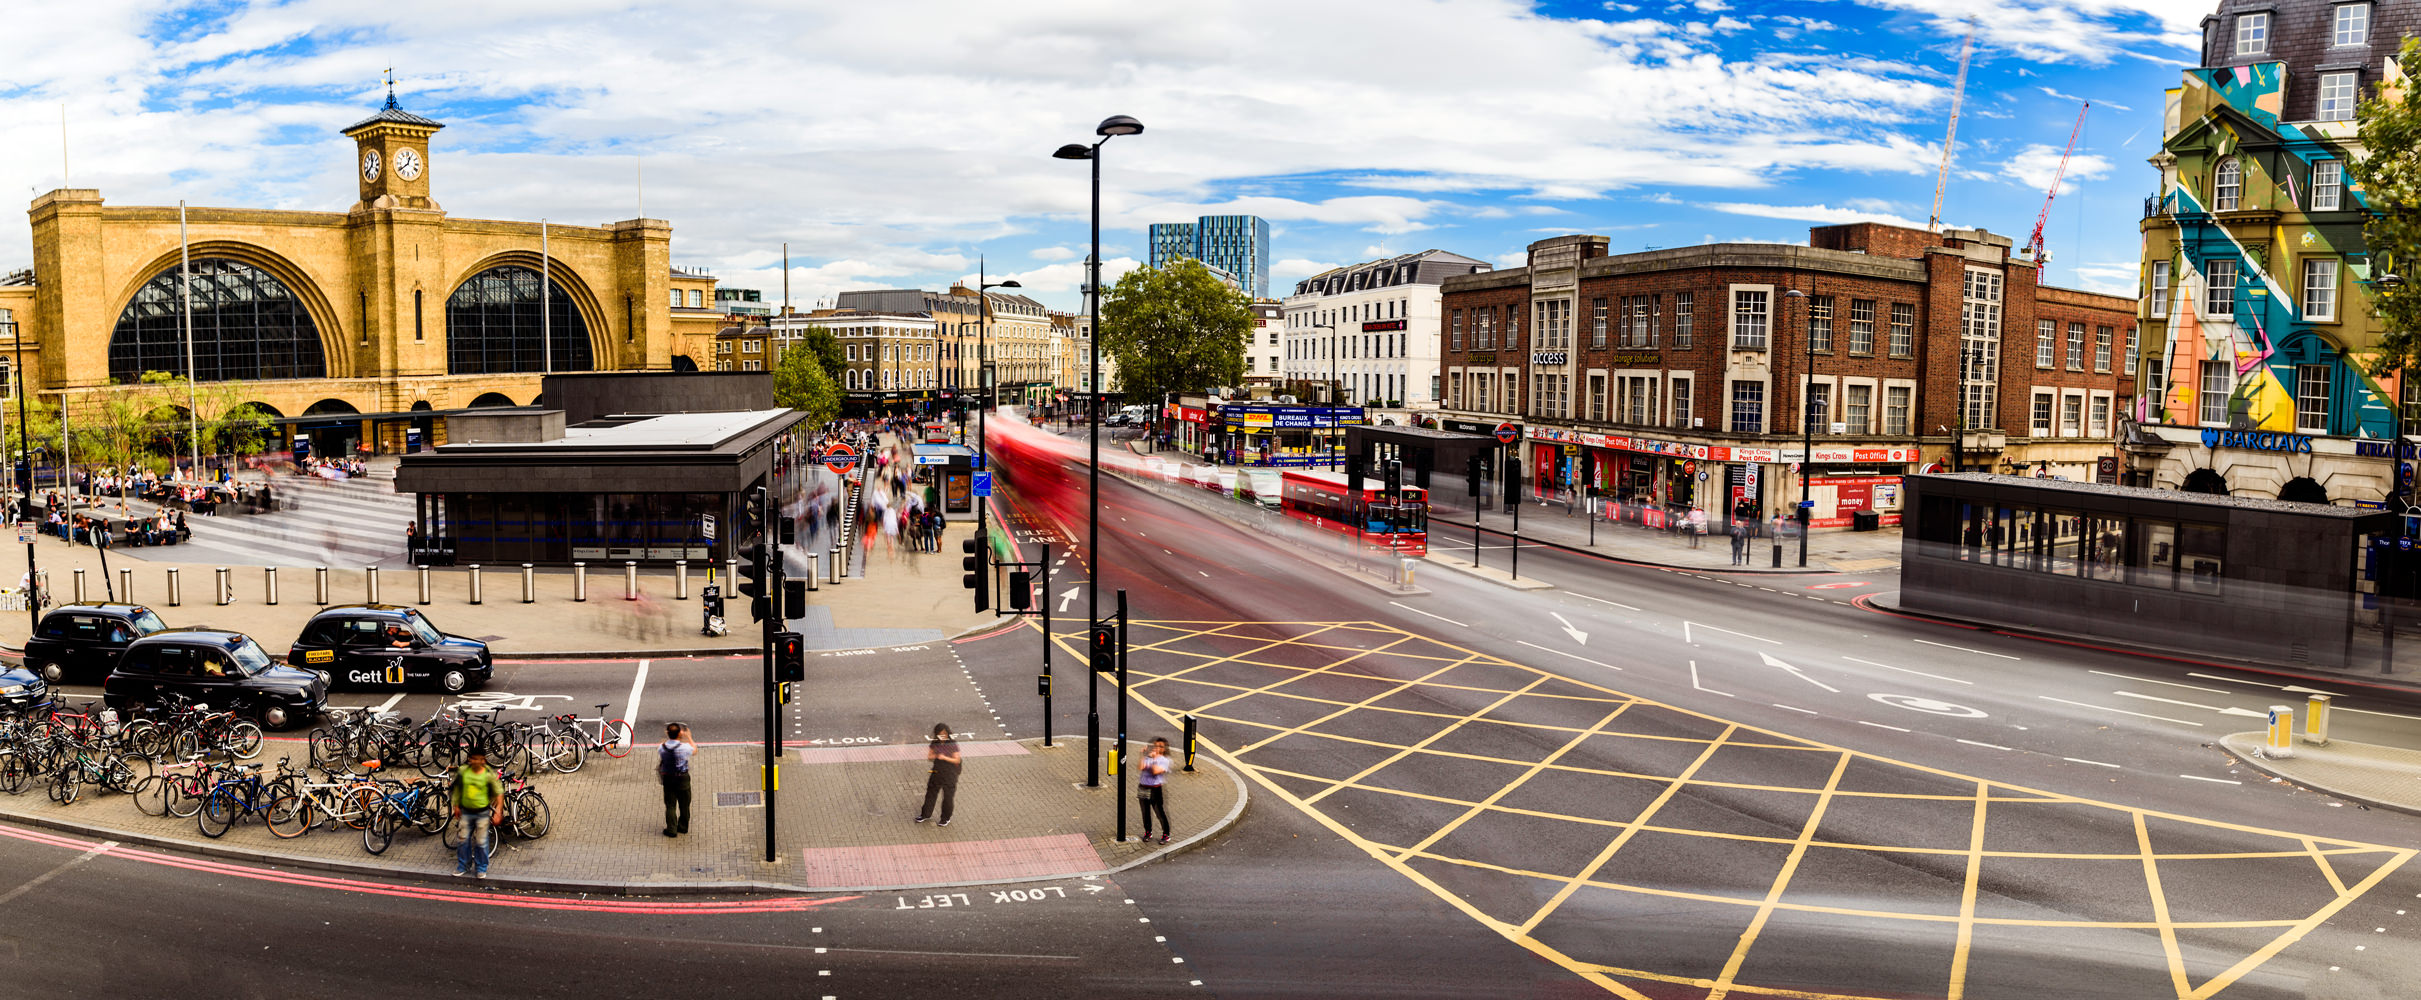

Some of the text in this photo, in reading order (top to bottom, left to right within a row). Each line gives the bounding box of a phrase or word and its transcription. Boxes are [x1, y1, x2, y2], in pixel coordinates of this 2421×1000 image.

[1532, 352, 1564, 364] access
[1614, 352, 1658, 366] storage solutions
[2223, 430, 2311, 454] BARCLAYS
[1816, 452, 1830, 461] Kings
[349, 670, 382, 683] Gett
[828, 732, 975, 745] LOOK LEFT
[896, 886, 1066, 910] LOOK LEFT
